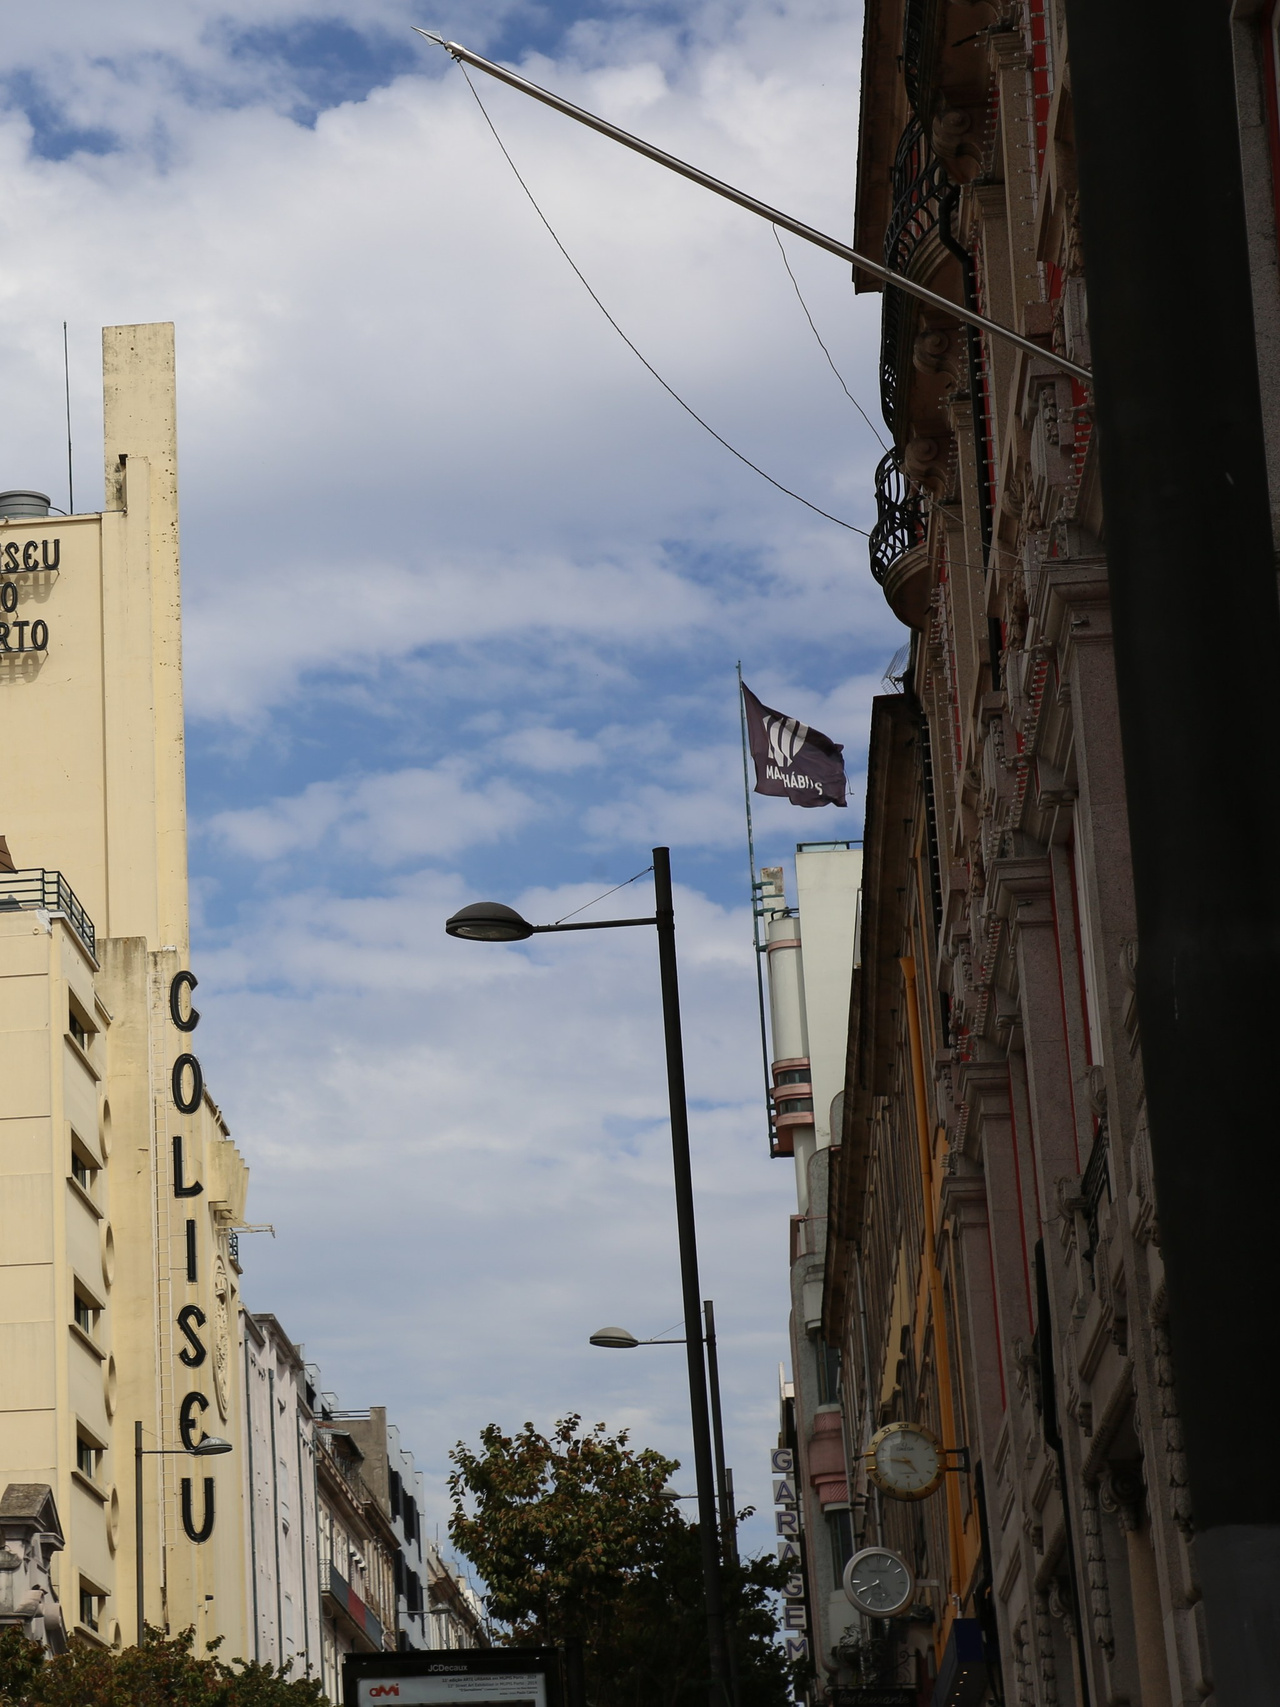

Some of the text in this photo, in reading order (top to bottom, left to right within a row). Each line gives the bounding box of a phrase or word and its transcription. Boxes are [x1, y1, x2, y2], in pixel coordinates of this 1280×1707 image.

[169, 970, 215, 1543] COLISEU
[772, 1449, 808, 1662] GARAGEM
[427, 1664, 468, 1673] JCDecaux
